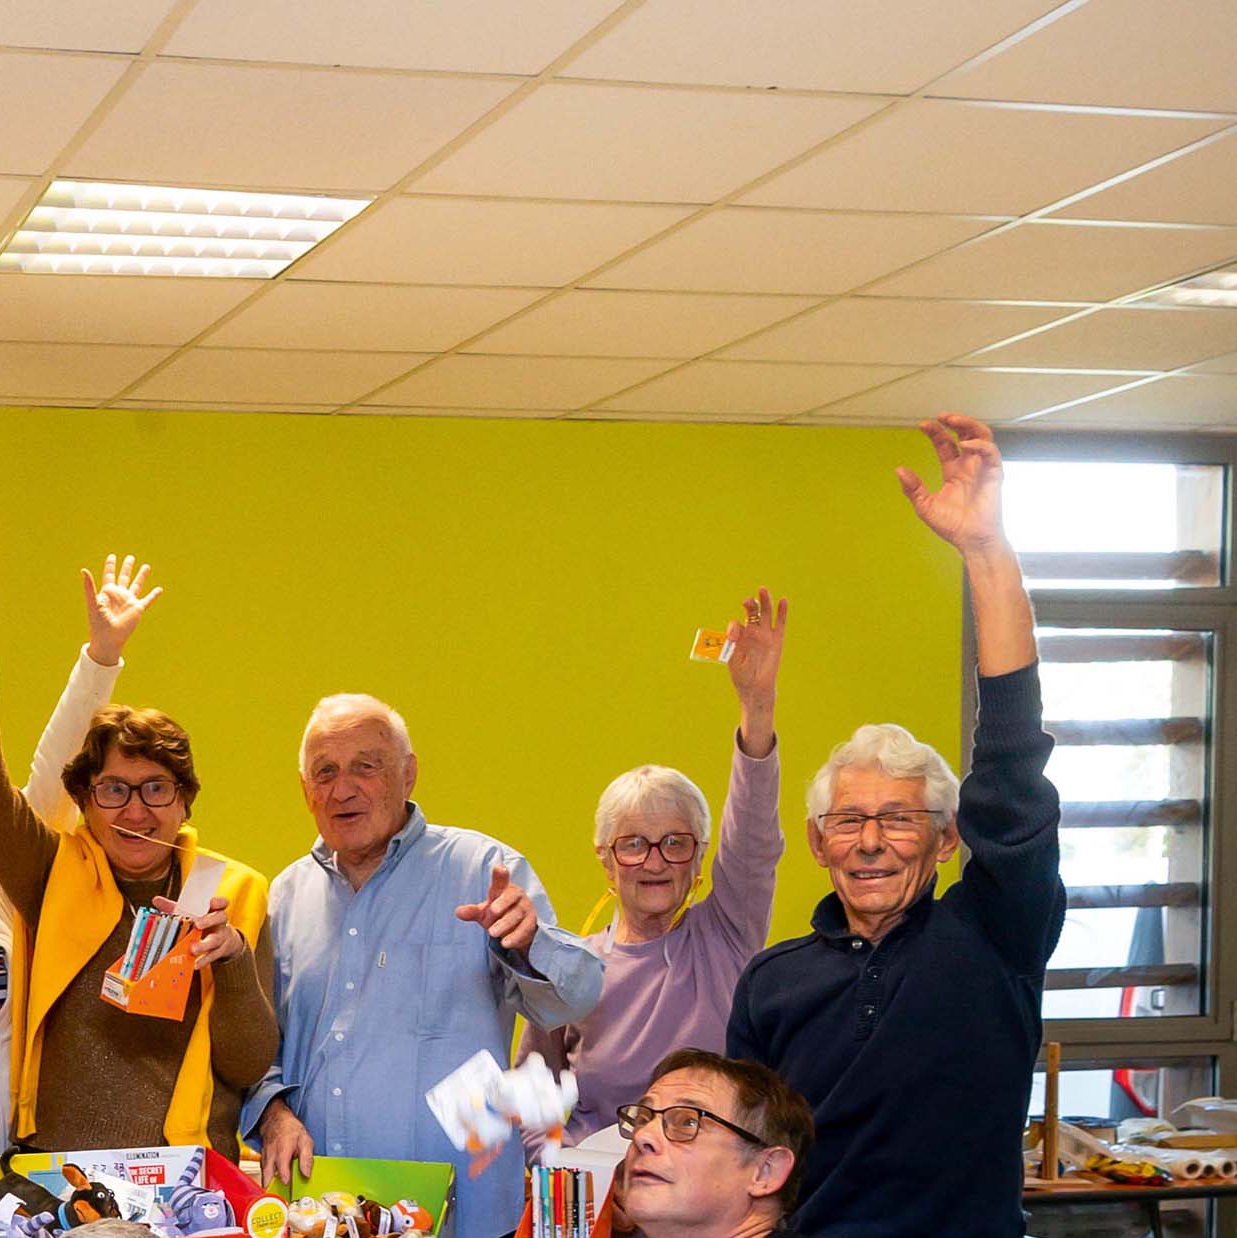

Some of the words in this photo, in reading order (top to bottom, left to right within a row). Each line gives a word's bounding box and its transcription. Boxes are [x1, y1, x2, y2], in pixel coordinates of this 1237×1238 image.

[126, 1152, 159, 1160] ILLUMINATION
[138, 1166, 163, 1175] SECRET
[134, 1175, 149, 1185] LIFE
[251, 1211, 282, 1225] COLLECT
